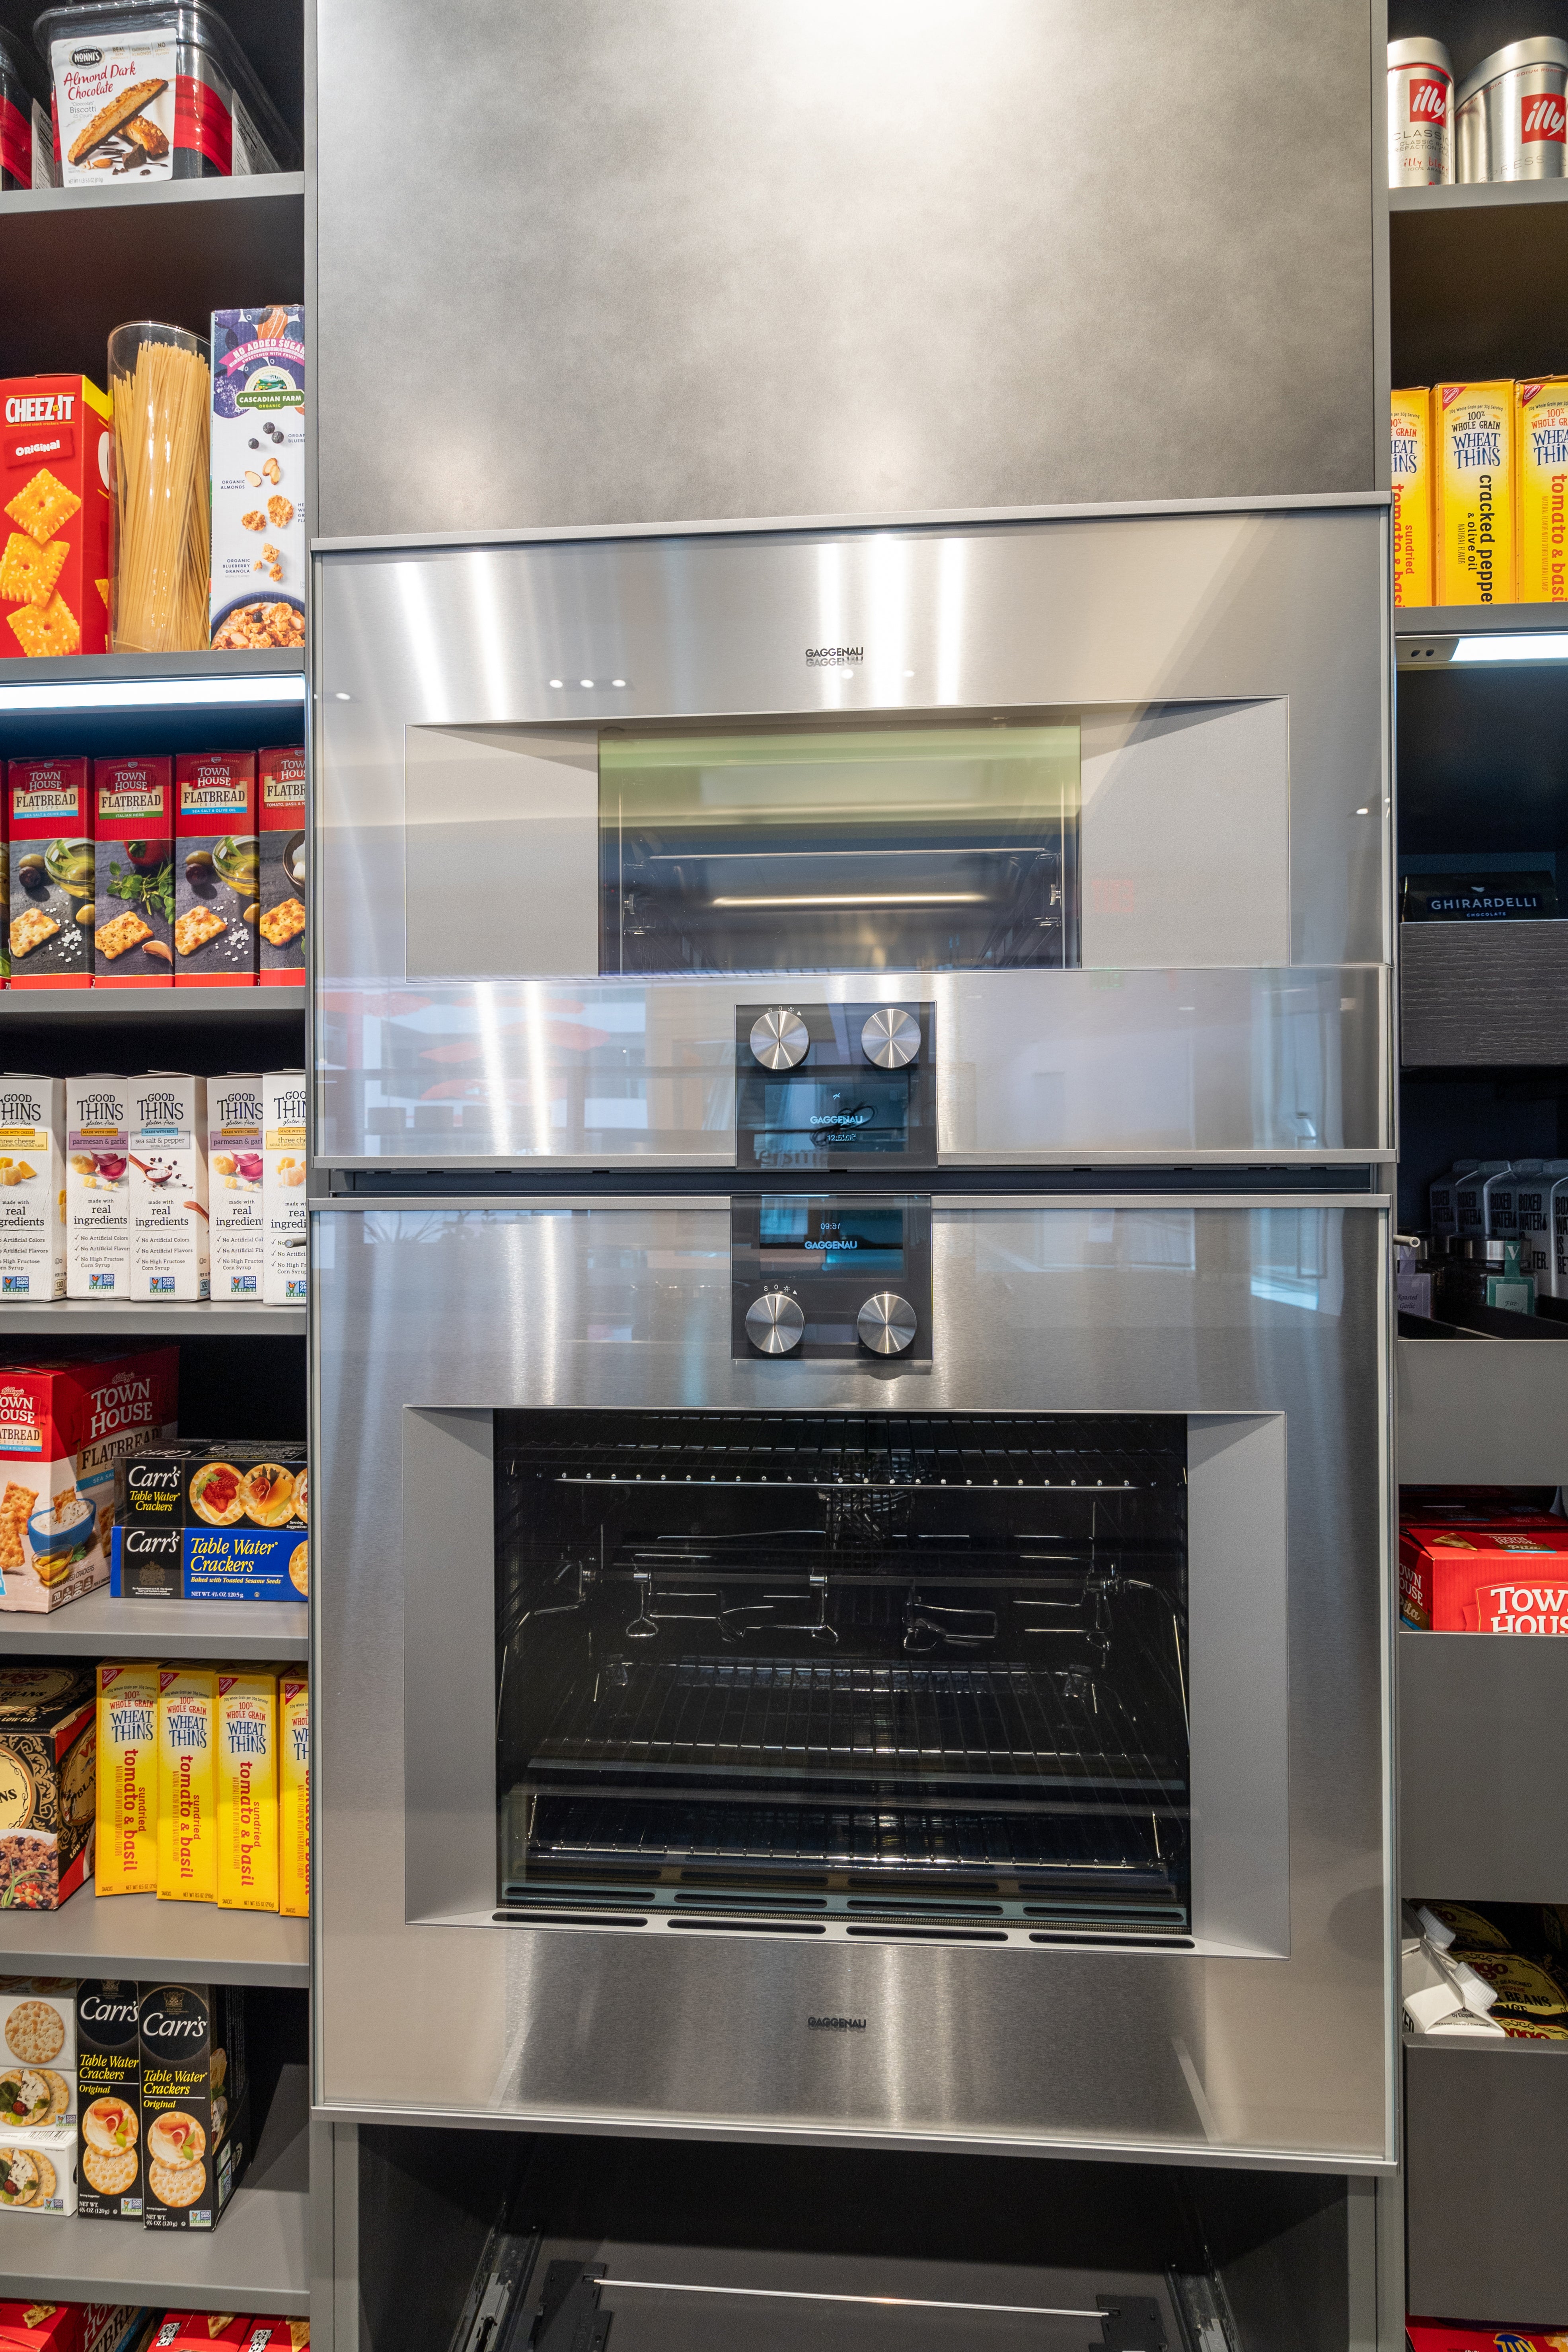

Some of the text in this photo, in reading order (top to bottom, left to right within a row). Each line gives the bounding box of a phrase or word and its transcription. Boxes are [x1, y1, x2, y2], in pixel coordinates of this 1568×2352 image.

[74, 52, 100, 62] NONNI'S
[64, 61, 136, 86] Almond Dark
[68, 80, 113, 100] Chocolate
[1412, 85, 1445, 119] illy
[1525, 100, 1565, 136] illy
[1404, 158, 1422, 168] illy
[232, 346, 245, 358] NO
[247, 339, 277, 352] ADDED
[242, 353, 269, 363] SWEETENED
[1468, 411, 1485, 421] 100%
[1451, 421, 1500, 433] WHOLE GRAIN
[1451, 432, 1500, 450] WHEAT
[1480, 474, 1495, 544] cracked
[1468, 522, 1477, 551] olive
[1405, 525, 1415, 575] sundried
[1468, 555, 1477, 571] oil
[805, 647, 863, 657] GAGGENAU
[30, 771, 61, 781] TOWN
[115, 772, 146, 781] TOWN
[198, 767, 230, 777] TOWN
[29, 781, 62, 791] HOUSE
[115, 781, 147, 791] HOUSE
[197, 776, 231, 787] HOUSE
[16, 794, 76, 808] FLATBREAD
[101, 795, 161, 808] FLATBREAD
[184, 791, 245, 803] FLATBREAD
[1431, 898, 1537, 910] GHIRARDELLI
[88, 1094, 115, 1103] GOOD
[148, 1093, 175, 1102] GOOD
[76, 1099, 124, 1121] THINS
[137, 1099, 183, 1120] THINS
[810, 1116, 863, 1125] GAGGENAU
[1519, 1194, 1542, 1211] BOXED
[152, 1206, 170, 1215] real
[136, 1217, 189, 1228] ingredients
[1519, 1212, 1542, 1230] WATER
[804, 1241, 857, 1249] GAGGENAU
[91, 1379, 150, 1413] TOWN
[90, 1402, 152, 1439] HOUSE
[129, 1465, 180, 1487] Carr's
[130, 1491, 179, 1501] Table Water
[136, 1502, 172, 1512] Crackers
[127, 1531, 179, 1553] Carr's
[191, 1537, 275, 1555] Table Water
[191, 1556, 254, 1572] Crackers
[109, 1710, 154, 1725] WHEAT
[226, 1711, 266, 1721] WHOLE GRAIN
[226, 1721, 266, 1736] WHEAT
[124, 1749, 138, 1810] tomato
[138, 1787, 147, 1832] sundried
[240, 1761, 254, 1886] tomato basil
[123, 1830, 138, 1872] basil
[1504, 1991, 1552, 2007] BEANS
[143, 2013, 206, 2037] Carr's
[808, 2017, 866, 2028] GAGGENAU
[80, 2054, 107, 2067] Table
[80, 2067, 124, 2080] Crackers
[144, 2070, 205, 2082] Table Water
[79, 2085, 111, 2095] Original
[143, 2083, 190, 2095] Crackers
[144, 2100, 176, 2109] Original
